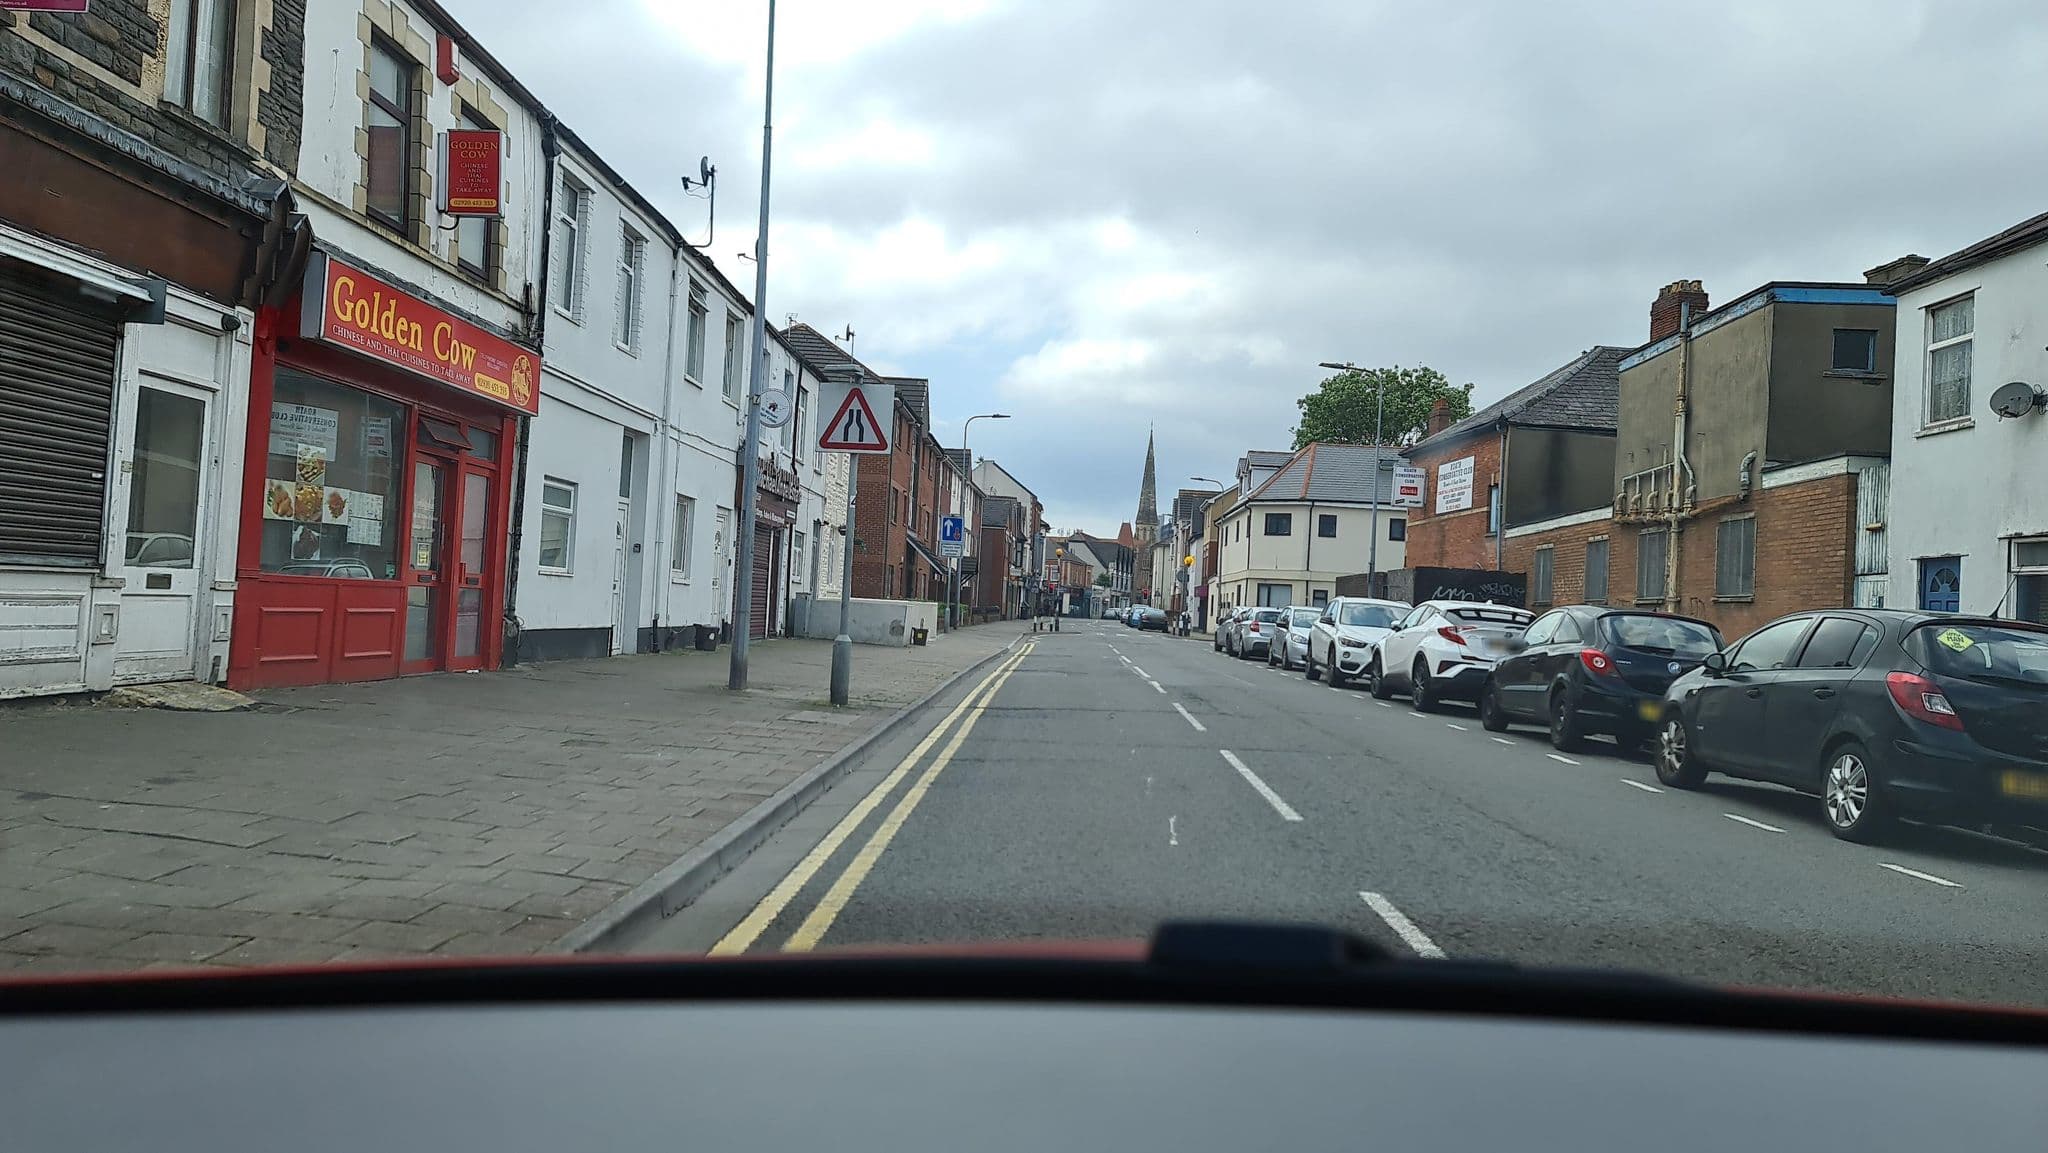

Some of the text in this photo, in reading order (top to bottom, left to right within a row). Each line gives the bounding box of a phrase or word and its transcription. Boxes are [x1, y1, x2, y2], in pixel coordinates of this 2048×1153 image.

[450, 141, 498, 150] GOLDEN
[460, 150, 488, 158] COW
[333, 276, 477, 371] Golden Cow
[332, 324, 365, 345] CHINESE
[366, 338, 382, 352] AND
[383, 343, 400, 358] THAI
[401, 351, 430, 370] CUISINES
[431, 362, 440, 373] TO
[455, 373, 472, 385] AWAY
